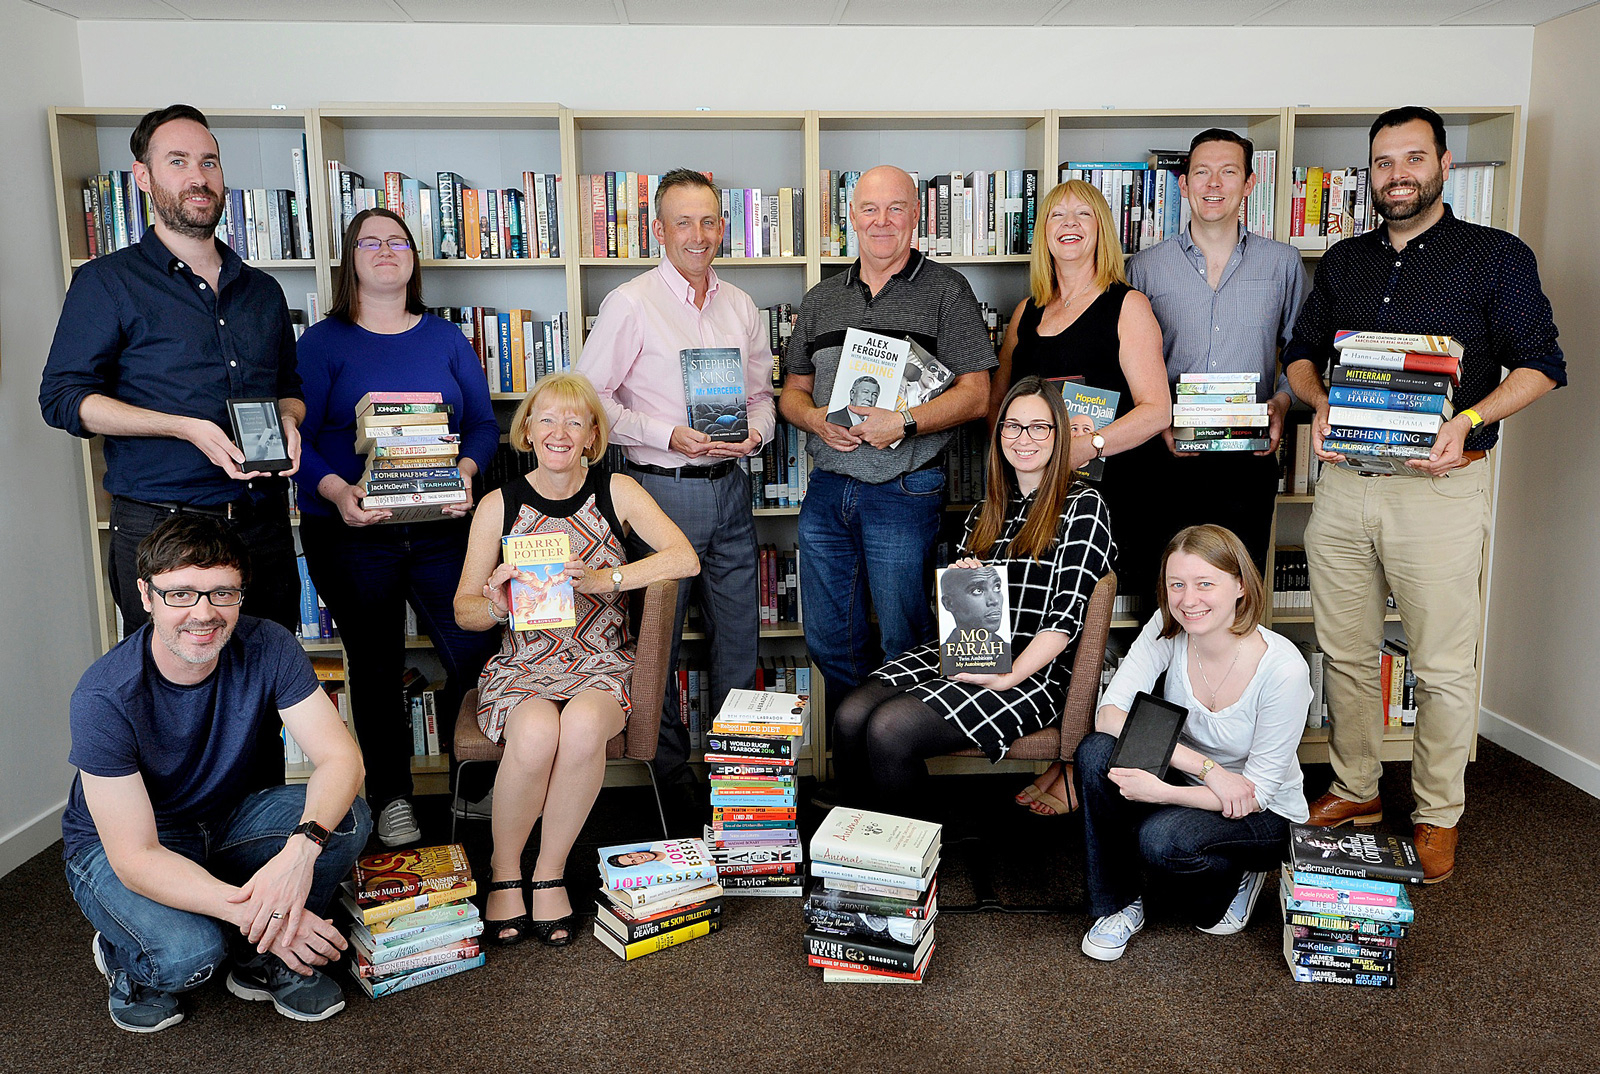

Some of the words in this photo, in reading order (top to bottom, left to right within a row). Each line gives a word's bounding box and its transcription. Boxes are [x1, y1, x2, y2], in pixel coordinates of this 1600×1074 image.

[341, 172, 350, 191] JACK
[439, 180, 453, 214] KING
[593, 175, 606, 212] SIGNAL
[594, 212, 605, 232] RED
[939, 198, 949, 240] BATEMAN
[608, 222, 616, 250] DECEPTION
[866, 337, 889, 350] ALEX
[852, 344, 899, 362] FERGUSON
[1380, 355, 1403, 363] Rudolf
[691, 358, 740, 371] STEPHEN
[848, 359, 894, 379] LEADING
[700, 370, 736, 384] KING
[1346, 370, 1391, 382] MITTERRAND
[706, 386, 742, 395] MERCEDES
[1075, 393, 1107, 406] Hopeful
[1347, 395, 1384, 405] HARRIS
[1397, 393, 1432, 402] OFFICER
[1409, 400, 1424, 408] SPY
[1064, 399, 1090, 415] Omid
[1090, 405, 1115, 420] Djalili
[1335, 428, 1382, 440] STEPHEN
[1391, 432, 1420, 443] KING
[391, 446, 427, 455] STRANDED
[371, 483, 384, 491] Jack
[384, 482, 410, 490] McDevitt
[514, 538, 562, 550] HARRY
[514, 548, 564, 559] POTTER
[960, 628, 989, 642] MO
[946, 641, 1004, 657] FARAH
[756, 693, 769, 712] LABRADOR
[724, 766, 765, 774] POINTLESS
[664, 842, 687, 865] JOEY
[677, 840, 702, 867] ESSEX
[1355, 833, 1383, 864] Cornwell
[718, 866, 753, 874] POINTLESS
[1306, 862, 1334, 874] Bernard
[1334, 867, 1367, 878] Cornwell
[426, 875, 459, 886] VANISHING
[614, 875, 654, 890] JOEY
[657, 869, 704, 884] ESSEX
[734, 878, 767, 887] Taylor
[1300, 877, 1332, 887] DOWLING
[358, 890, 381, 900] KAREN
[381, 884, 415, 898] MAITLAND
[370, 907, 387, 915] Adele
[387, 899, 411, 912] PARKS
[1310, 900, 1327, 908] THE
[1330, 902, 1362, 912] DEVIL'S
[634, 926, 660, 939] DEAVER
[660, 921, 670, 929] THE
[670, 916, 685, 927] SKIN
[686, 909, 712, 921] COLLECTOR
[1292, 914, 1319, 927] JONATHAN
[1319, 915, 1350, 930] KELLERMAN
[1362, 923, 1380, 934] GUILT
[1330, 932, 1354, 942] NADEL
[810, 940, 843, 952] IRVINE
[1308, 942, 1333, 952] Keller
[1336, 944, 1360, 955] Bitter
[1360, 948, 1382, 958] River
[810, 947, 844, 960] WELSH
[375, 958, 421, 972] ATONEMENT
[434, 952, 456, 962] BLOOD
[868, 955, 898, 966] SKAGBOYS
[1309, 959, 1350, 969] PATTERSON
[1352, 958, 1375, 966] MARY,
[412, 969, 439, 981] RICHARD
[440, 964, 457, 974] FORD
[1311, 976, 1353, 984] PATTERSON
